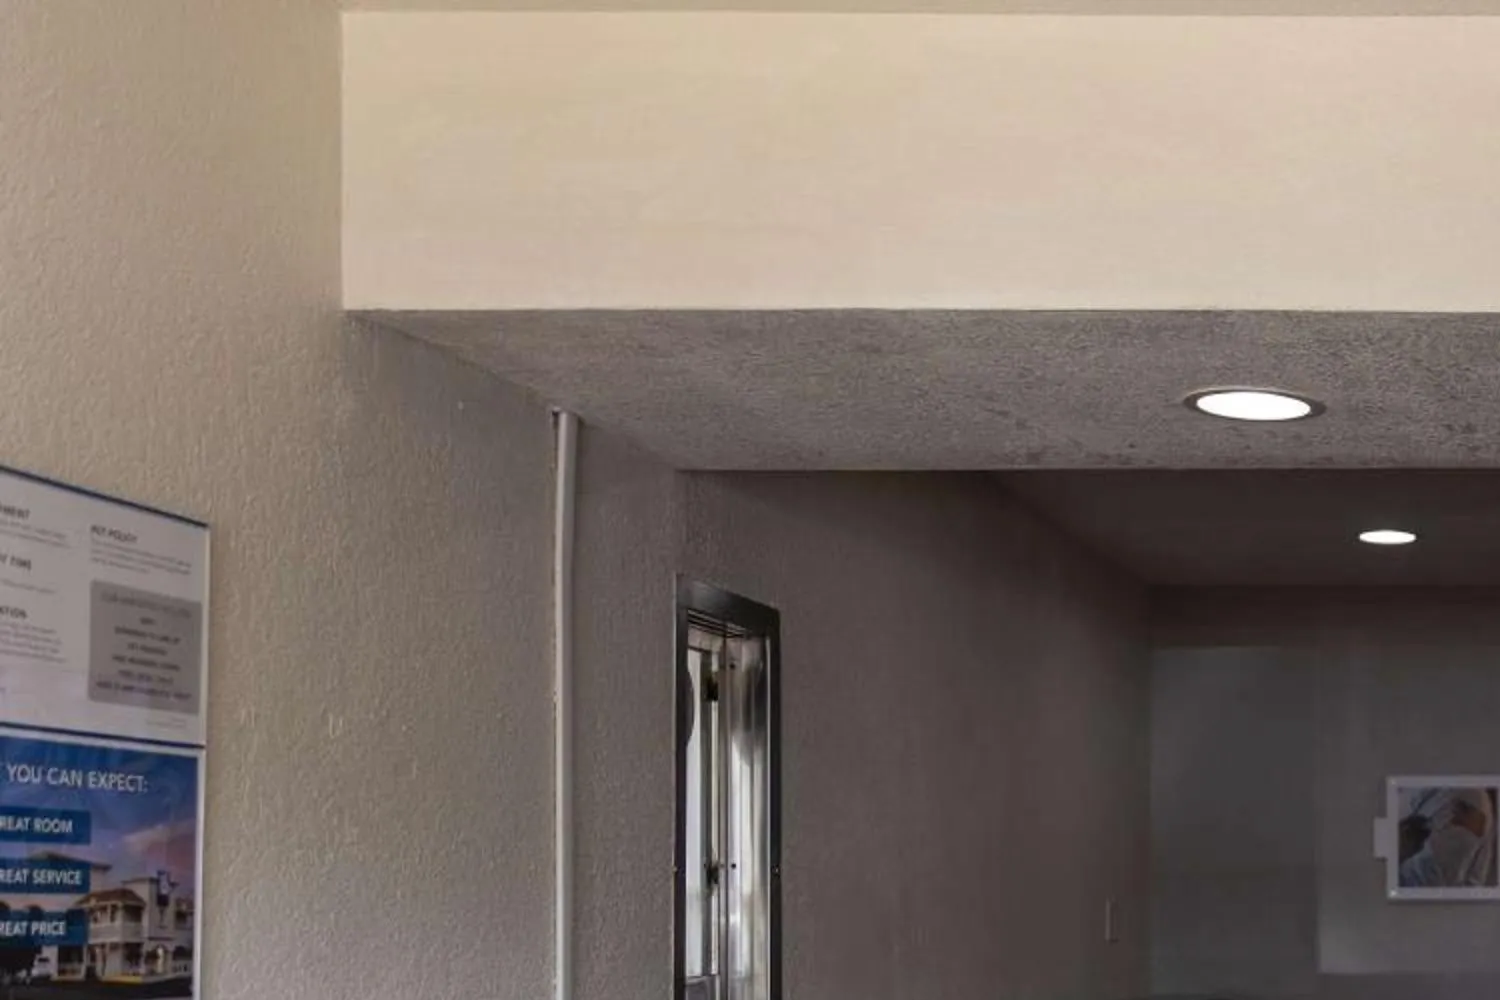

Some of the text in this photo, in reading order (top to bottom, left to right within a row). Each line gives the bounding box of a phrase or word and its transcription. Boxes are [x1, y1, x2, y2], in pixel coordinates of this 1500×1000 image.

[6, 762, 148, 794] YOU CAN EXPECT:
[0, 814, 73, 834] REAT ROOM
[0, 867, 82, 886] REAT SERVICE
[0, 920, 66, 937] REAT PRICE
